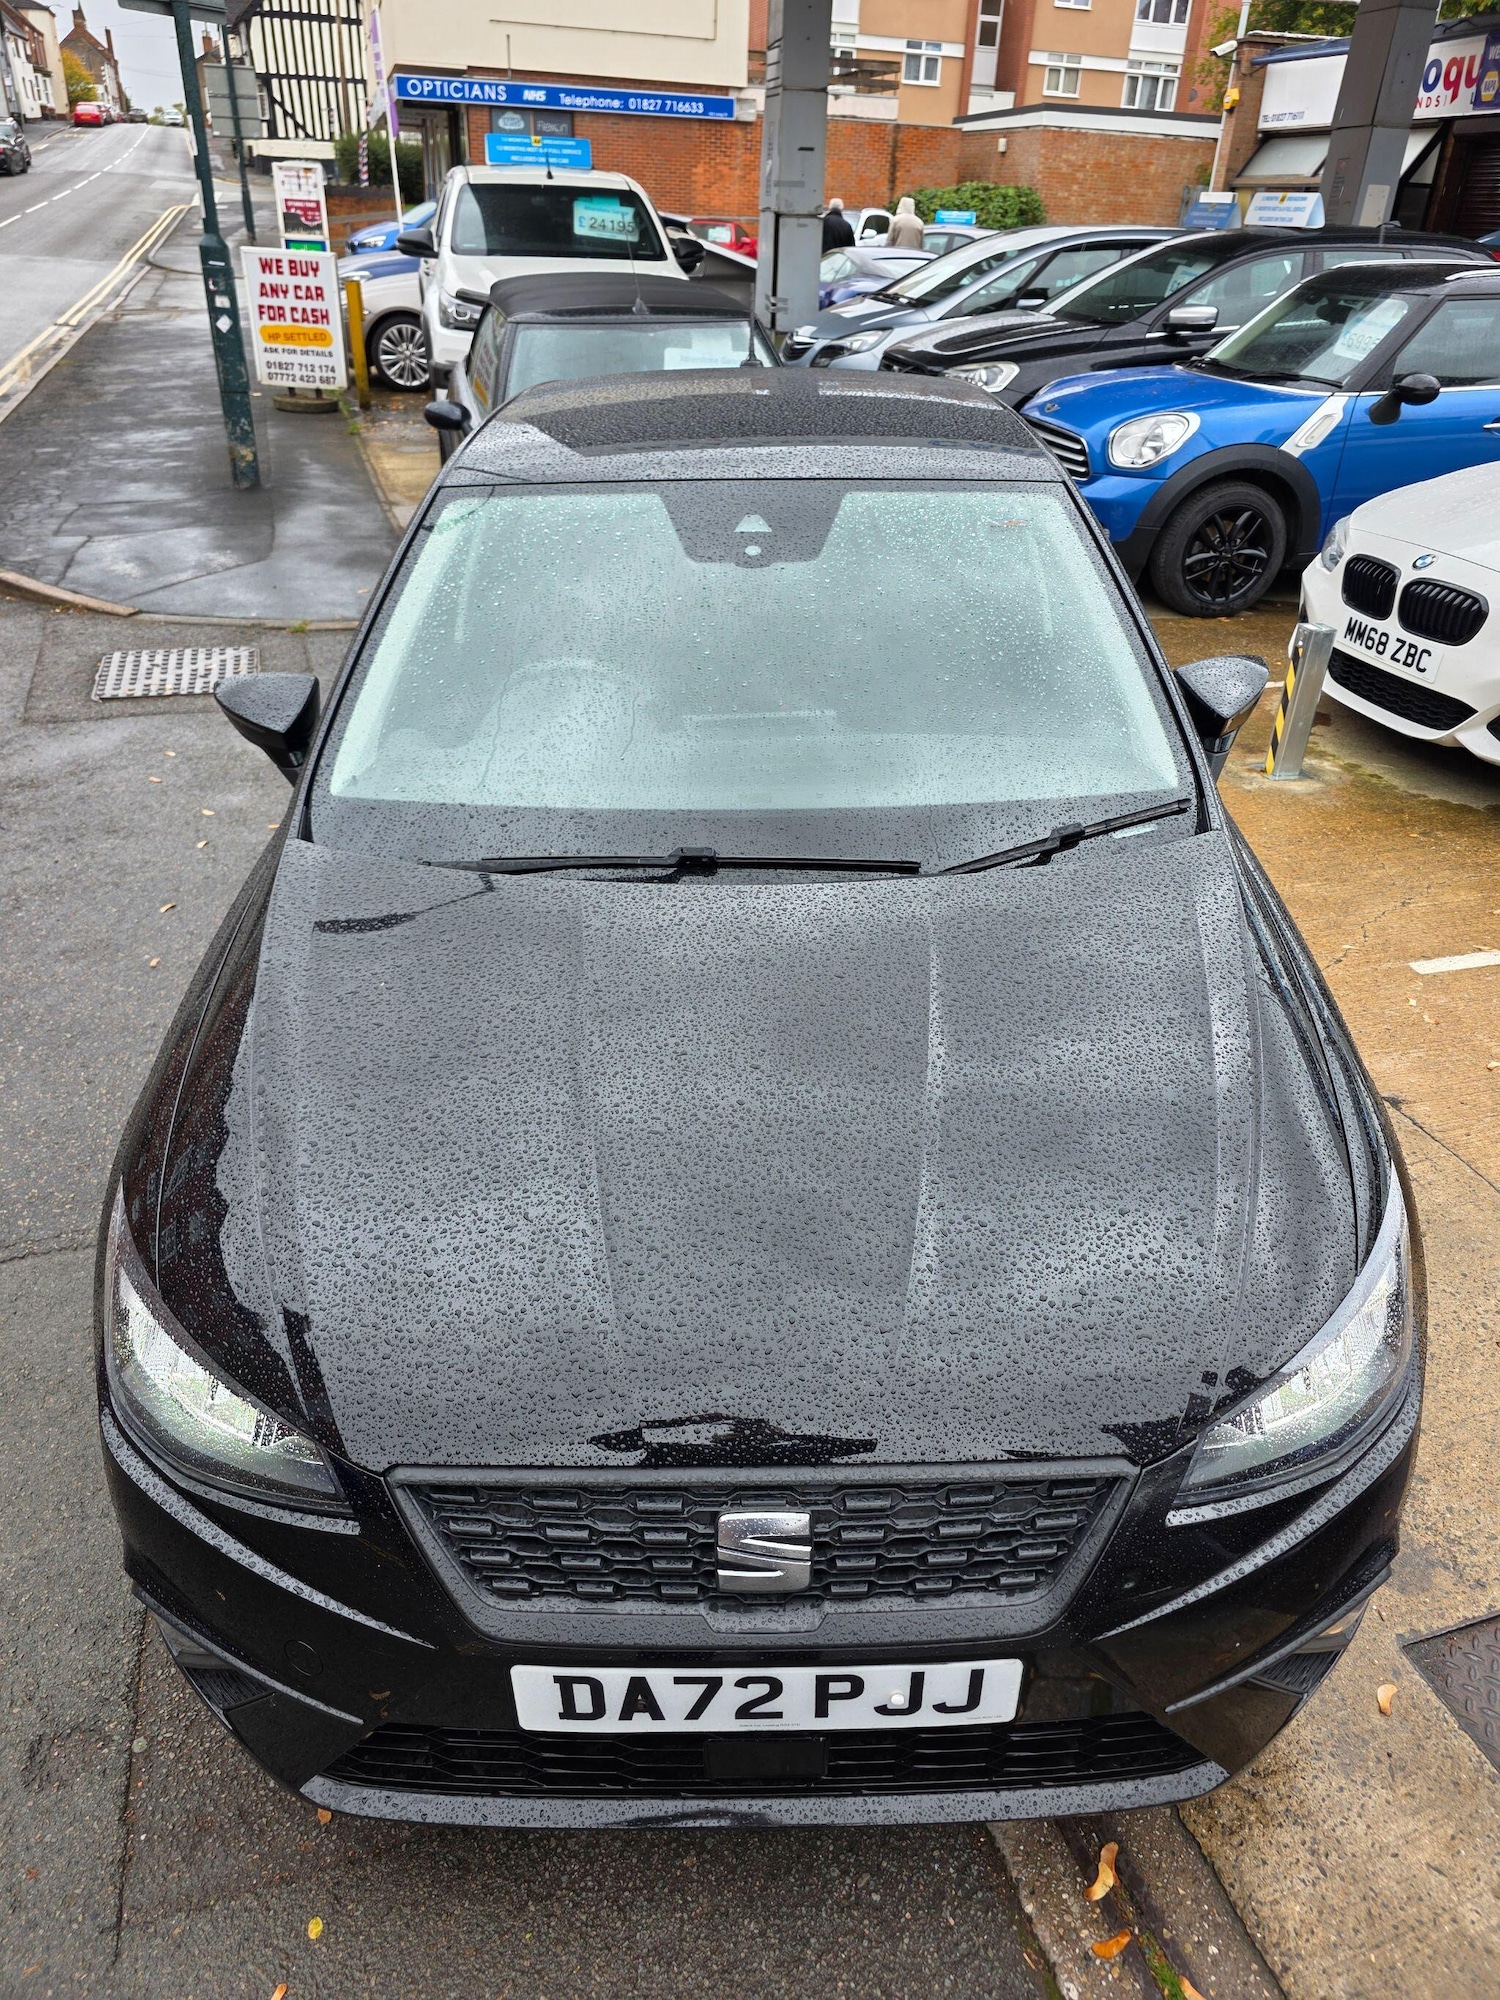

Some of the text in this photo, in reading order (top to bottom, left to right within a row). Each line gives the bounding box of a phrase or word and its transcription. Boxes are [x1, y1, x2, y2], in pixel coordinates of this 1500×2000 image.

[406, 79, 704, 114] OPTICIANS NHS Telephone: 01827 716633
[259, 257, 320, 278] WE BUY
[259, 282, 325, 302] ANY CAR
[258, 304, 330, 325] FOR CASH
[268, 331, 327, 342] HP SETTLED
[263, 346, 333, 358] ASK FOR DETAILS
[266, 360, 336, 374] 01827 712 174
[267, 372, 336, 385] 07772 423 687
[1343, 616, 1432, 674] MM68 ZBC
[553, 1668, 985, 1722] DA72 PJJ
